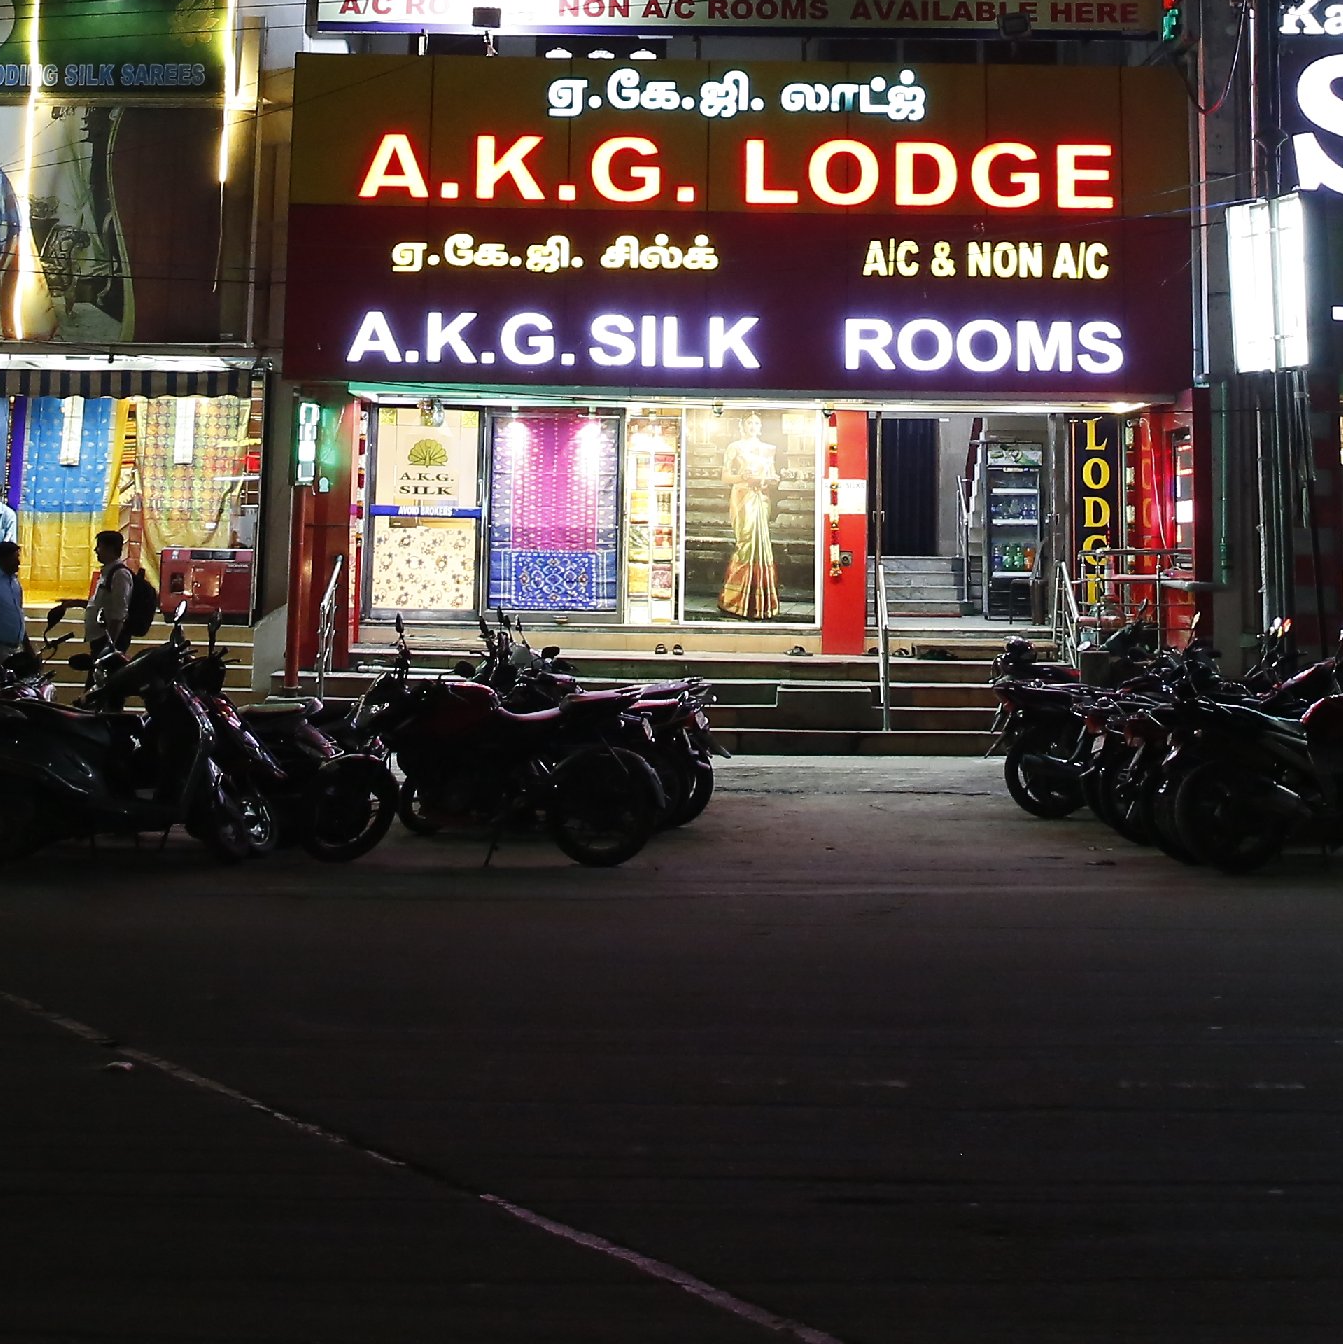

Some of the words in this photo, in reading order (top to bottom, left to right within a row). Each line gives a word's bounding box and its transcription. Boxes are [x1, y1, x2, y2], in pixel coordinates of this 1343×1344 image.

[707, 0, 829, 21] ROOMS
[1050, 3, 1139, 23] HERE
[64, 64, 116, 86] SILK
[120, 63, 206, 86] SAREES
[548, 68, 765, 117] ஏ.கே.ஜி.
[781, 69, 926, 121] லாட்ஜ்
[359, 133, 695, 203] A.K.G.
[745, 139, 1114, 209] LODGE
[391, 234, 584, 272] ஏ.கே.ஜி.
[600, 233, 719, 270] சில்க்
[862, 238, 920, 277] A/C
[931, 241, 956, 278] &
[967, 241, 1043, 278] NON
[1052, 242, 1109, 279] A/C
[346, 311, 576, 365] A.K.G.
[588, 313, 761, 368] SILK
[844, 318, 1124, 374] ROOMS
[399, 486, 453, 496] SILK
[400, 472, 454, 482] A.K.G.
[398, 505, 420, 516] AVOID
